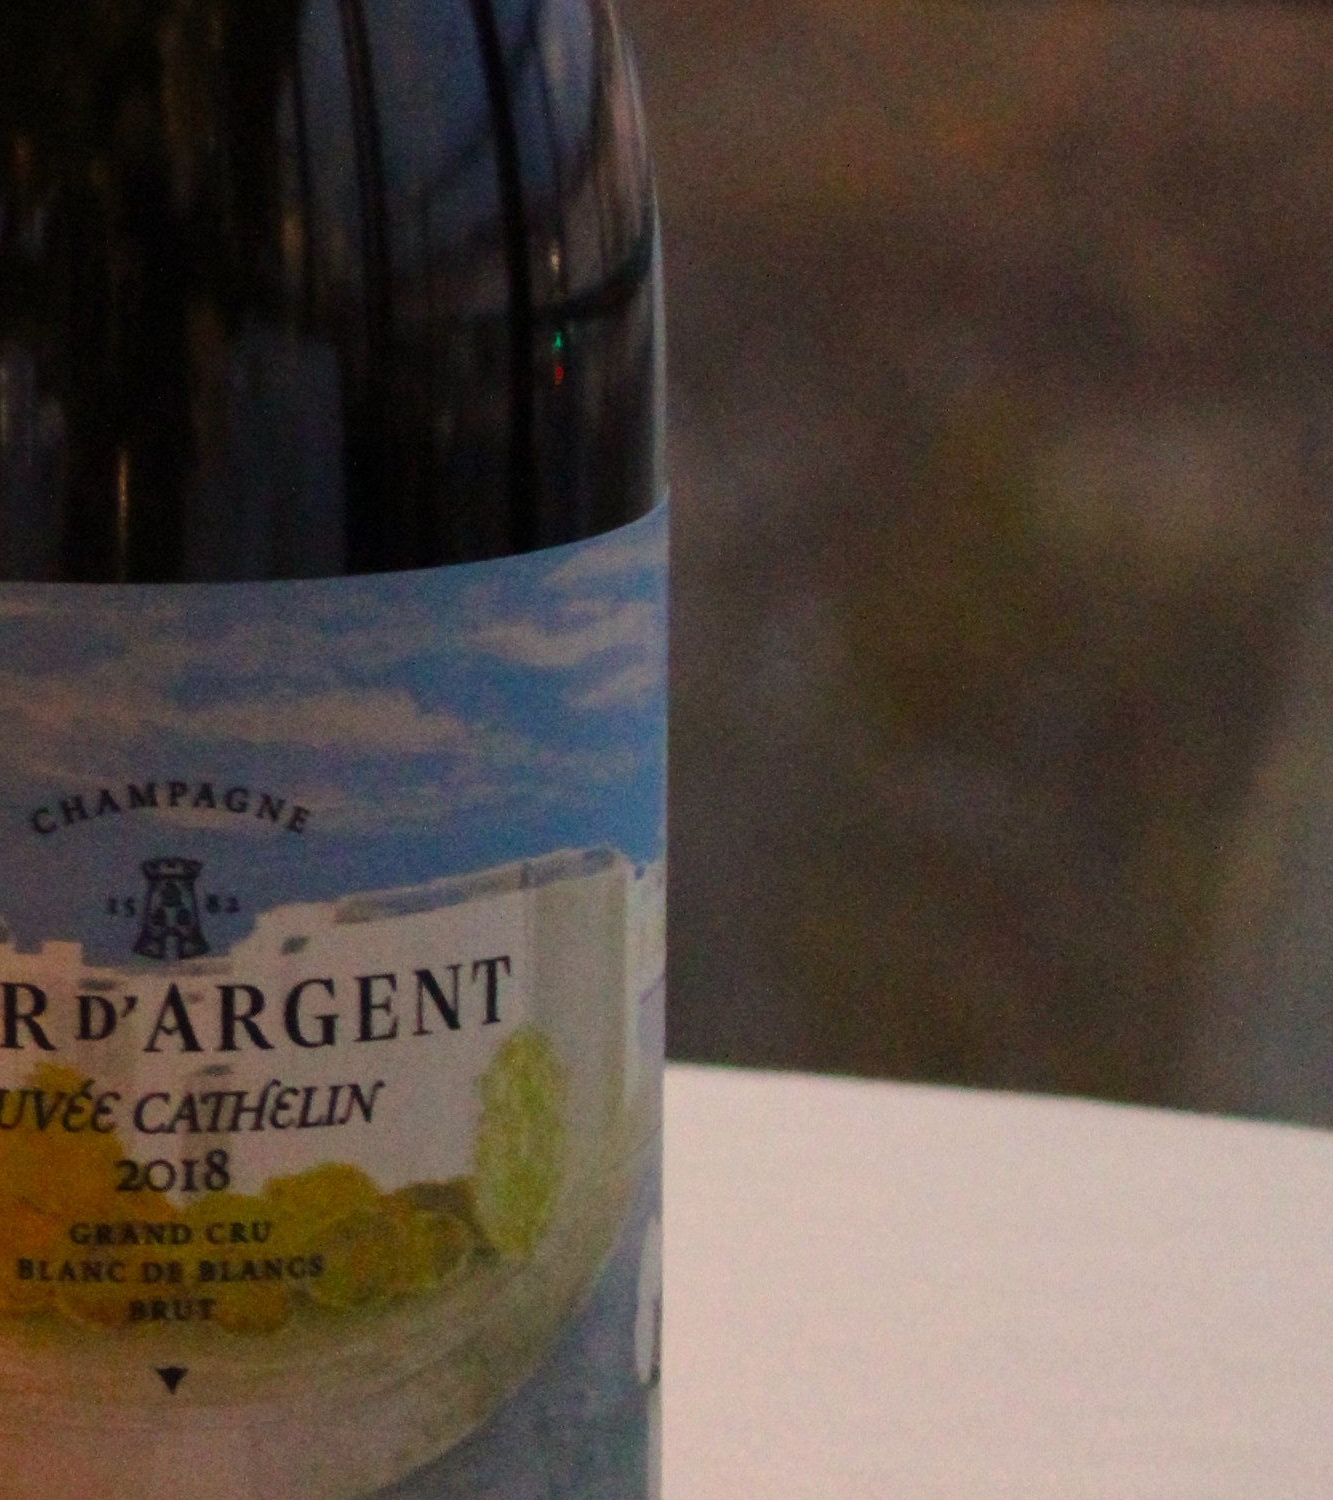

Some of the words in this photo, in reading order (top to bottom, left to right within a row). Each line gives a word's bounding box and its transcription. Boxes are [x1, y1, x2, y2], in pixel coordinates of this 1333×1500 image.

[31, 781, 312, 834] CHAMPAGNE
[74, 955, 512, 1054] D'ARGENT
[132, 1078, 386, 1135] CATHELIN
[114, 1148, 231, 1193] 2018
[68, 1221, 193, 1246] GRAND
[205, 1220, 274, 1245] CRU
[16, 1257, 126, 1284] BLANC
[142, 1261, 184, 1284] DE
[198, 1254, 325, 1283] BLANCS
[129, 1299, 217, 1321] BRUT
